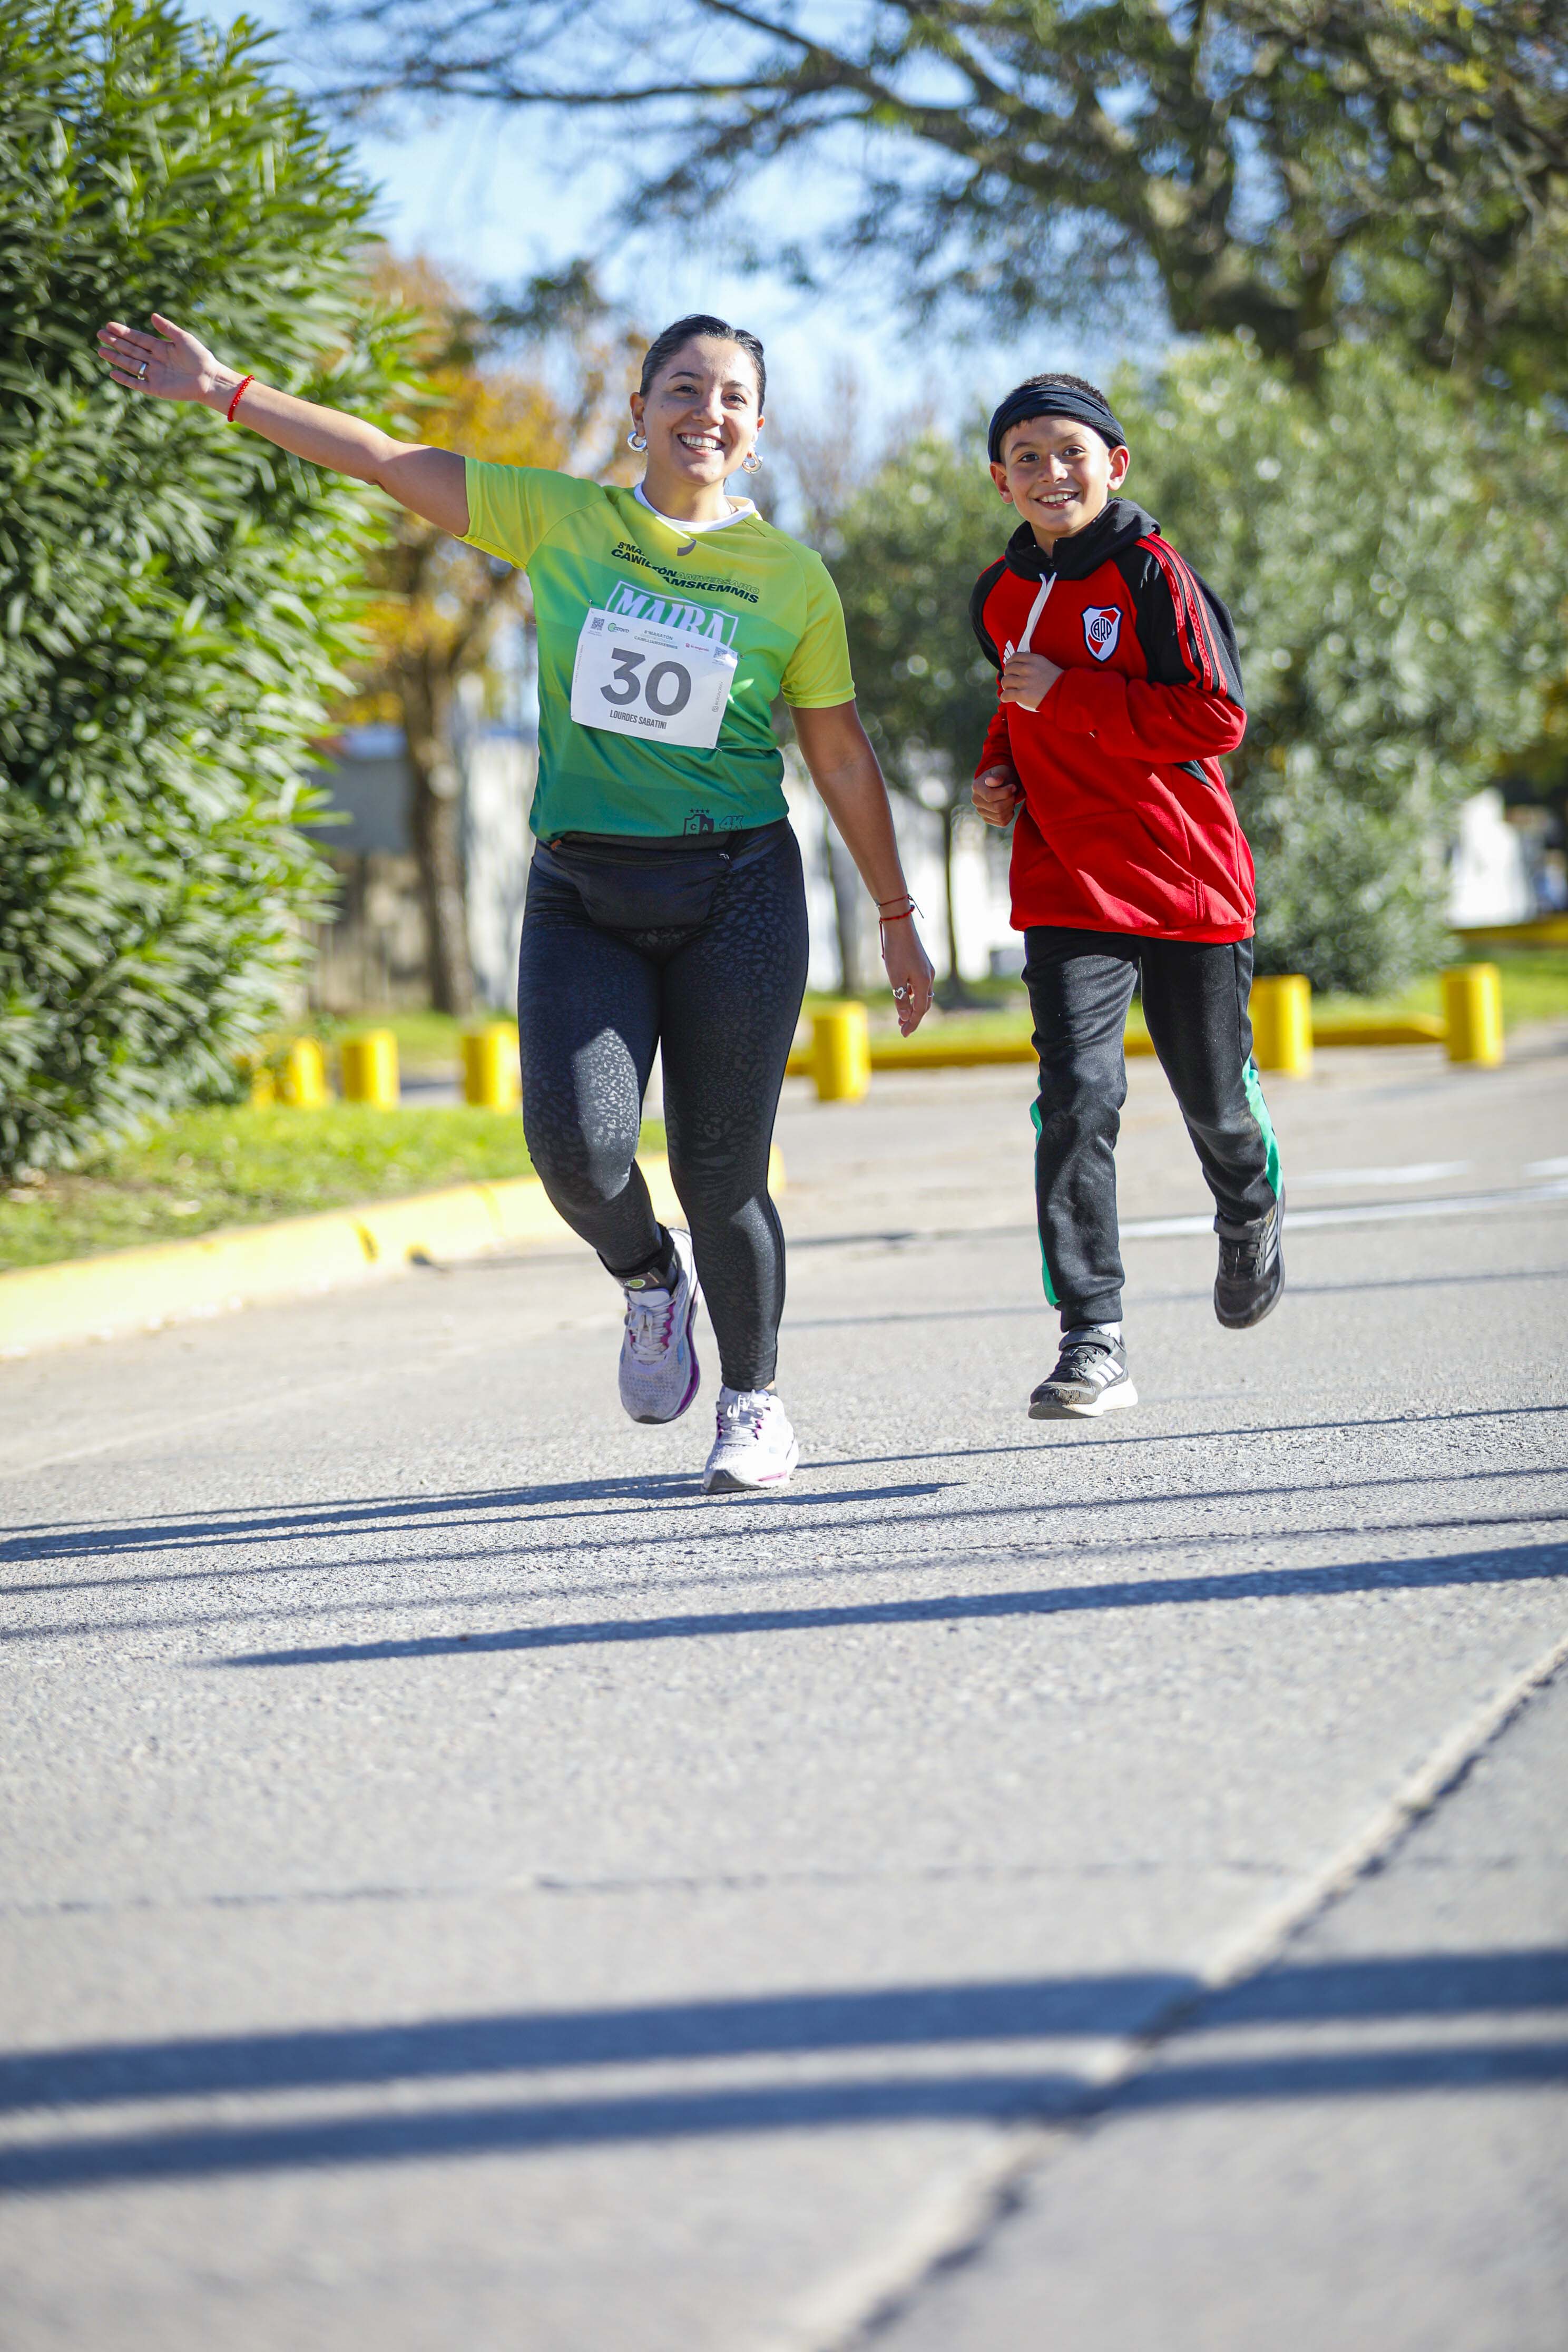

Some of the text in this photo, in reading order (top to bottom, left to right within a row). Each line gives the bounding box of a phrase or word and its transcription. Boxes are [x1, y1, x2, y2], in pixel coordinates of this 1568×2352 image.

[600, 648, 692, 716] 30
[610, 709, 667, 730] LOURDES SABATINI
